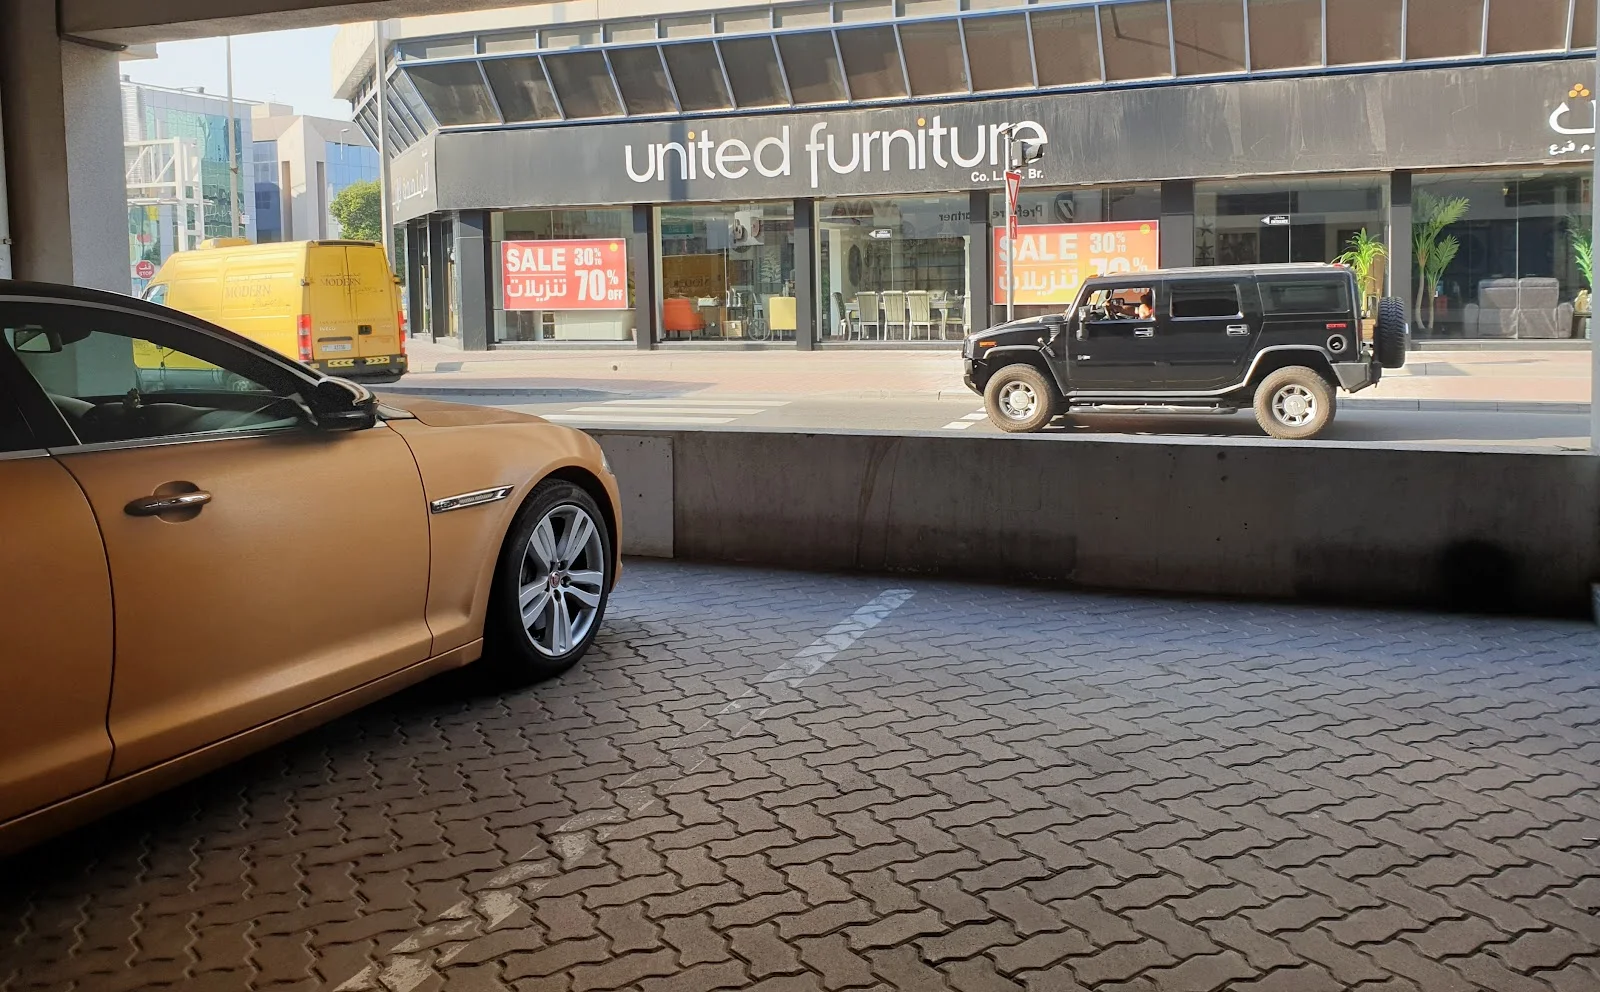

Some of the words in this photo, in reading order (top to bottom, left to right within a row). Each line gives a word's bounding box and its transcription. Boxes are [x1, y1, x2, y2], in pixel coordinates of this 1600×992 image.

[624, 125, 791, 183] united
[805, 115, 1048, 189] furniture
[971, 171, 990, 182] Co.
[1028, 168, 1044, 179] Br.
[999, 233, 1078, 262] SALE
[506, 247, 567, 273] SALE
[225, 283, 272, 299] MODERN
[320, 277, 361, 287] MODERN
[506, 278, 567, 302] تنزيلات
[607, 289, 623, 301] OFF
